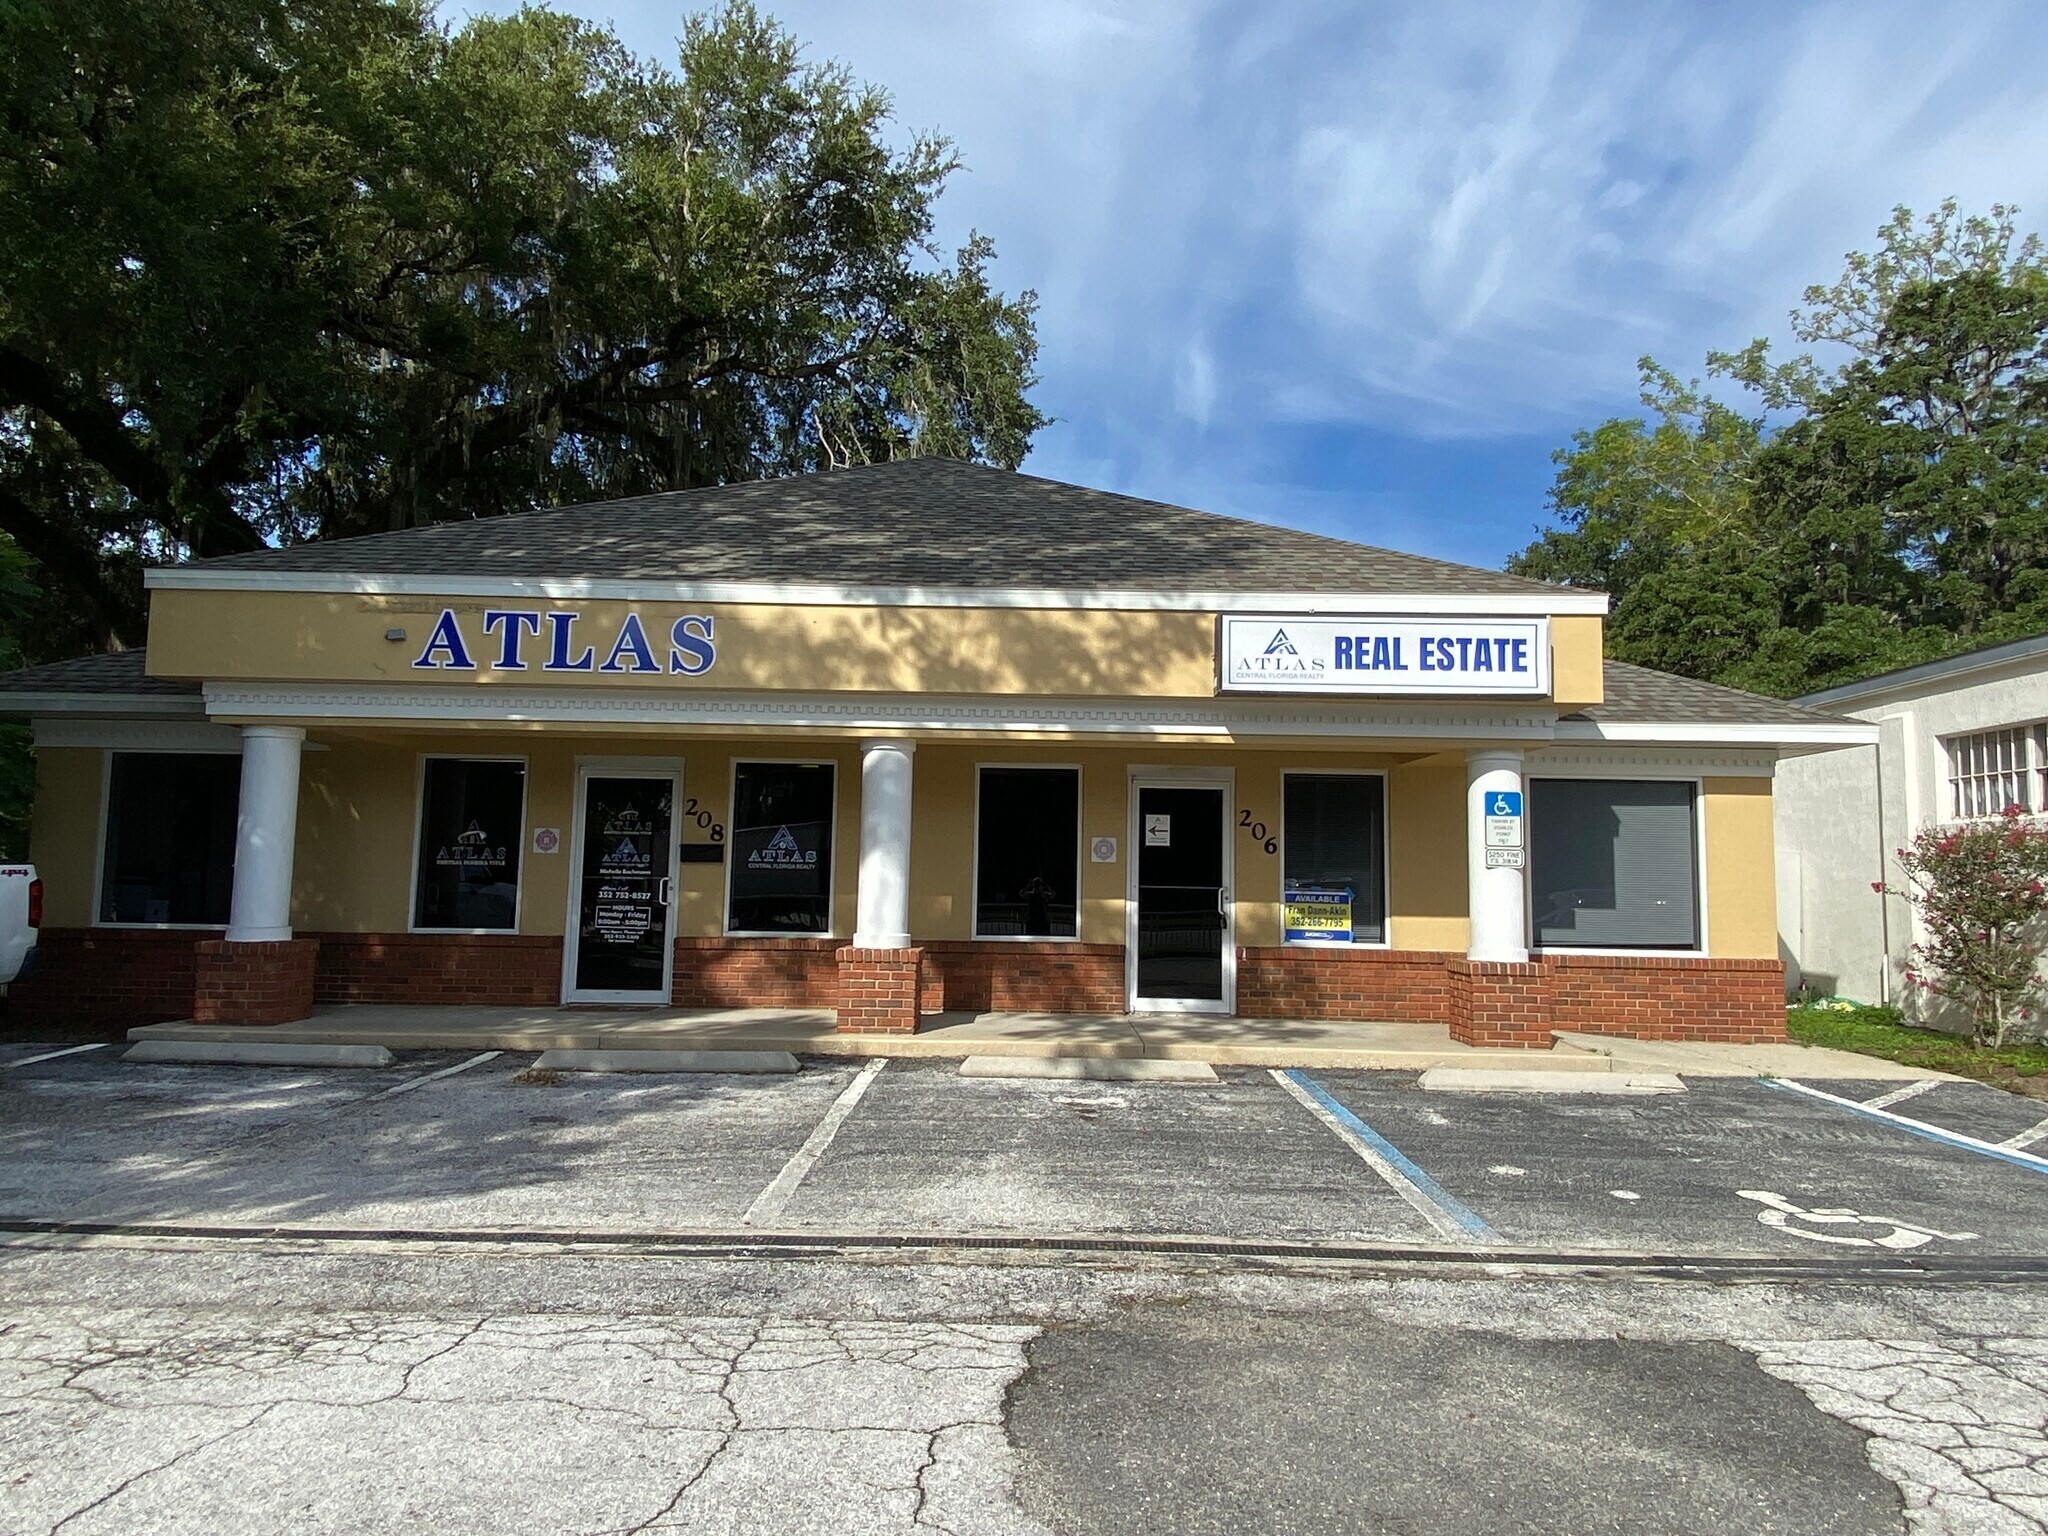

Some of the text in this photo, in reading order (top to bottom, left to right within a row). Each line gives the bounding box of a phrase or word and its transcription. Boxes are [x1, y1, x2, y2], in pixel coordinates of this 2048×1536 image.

[411, 608, 717, 676] ATLAS
[1334, 636, 1528, 672] REAL ESTATE
[1237, 657, 1325, 671] ATLAS
[685, 799, 724, 842] 208
[1239, 809, 1278, 855] 206
[436, 845, 506, 860] ATLAS
[601, 853, 651, 863] ATLAS
[748, 849, 818, 863] ATLAS
[598, 891, 613, 899] 352
[1294, 894, 1340, 903] AVAILABLE
